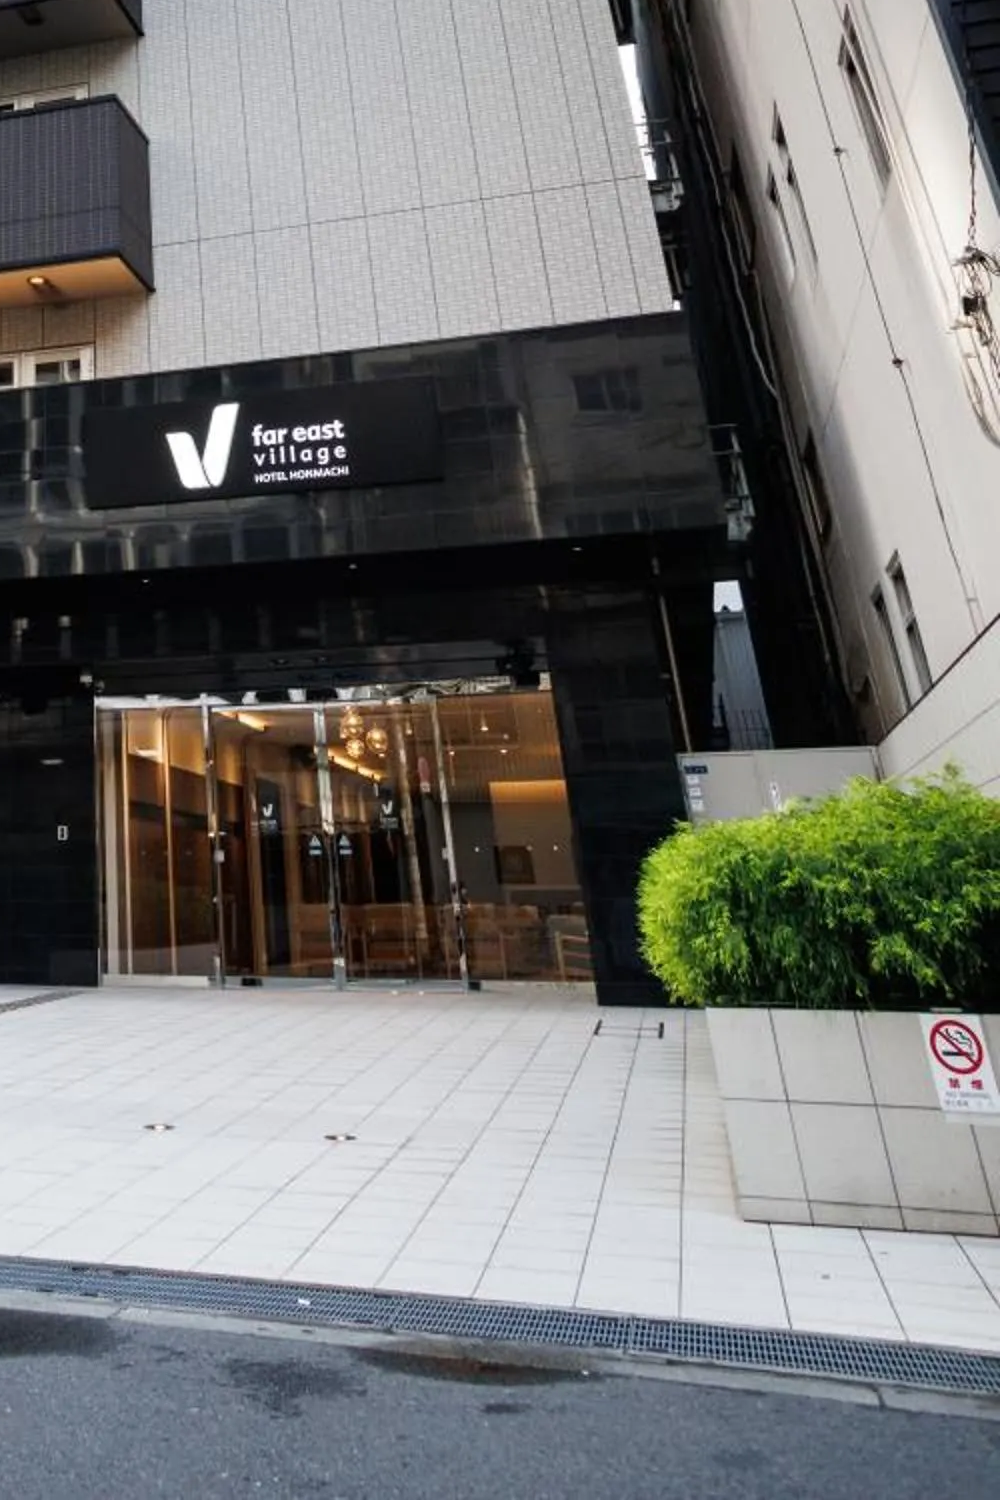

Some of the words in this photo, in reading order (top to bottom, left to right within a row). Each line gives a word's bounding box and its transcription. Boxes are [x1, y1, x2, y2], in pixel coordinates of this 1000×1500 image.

[251, 423, 288, 447] far
[291, 419, 345, 443] east
[253, 445, 347, 467] village
[254, 471, 288, 484] HOTEL
